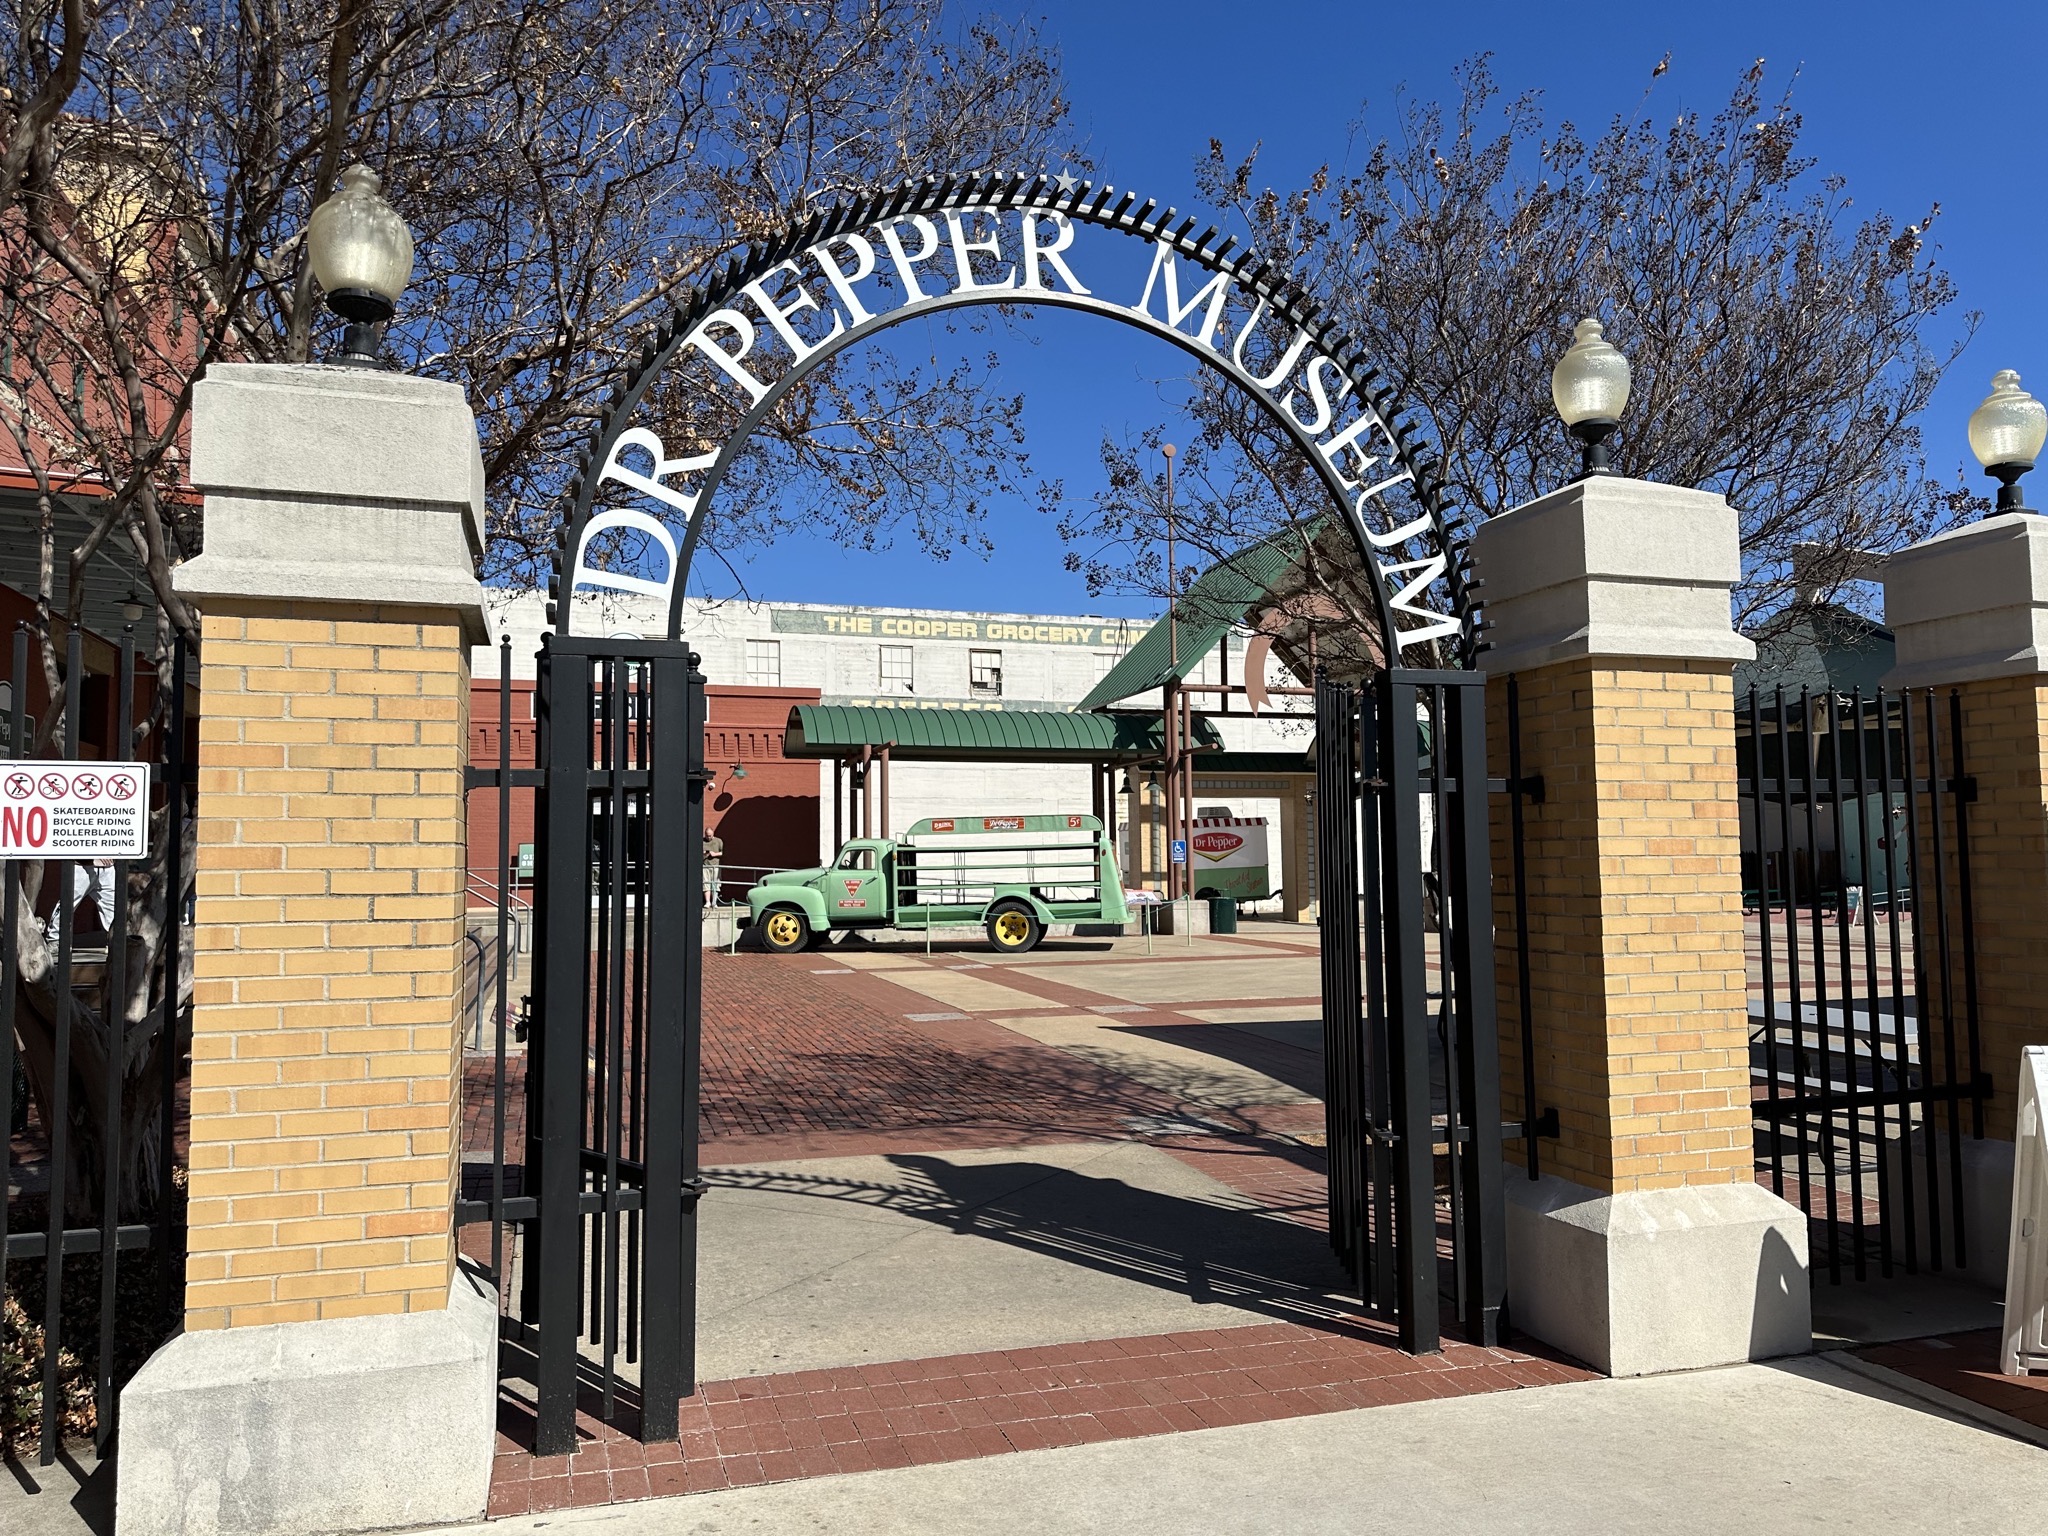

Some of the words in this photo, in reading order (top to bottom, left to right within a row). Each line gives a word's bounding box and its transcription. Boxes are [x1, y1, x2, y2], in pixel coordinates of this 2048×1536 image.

[574, 426, 722, 601] DR
[681, 206, 1092, 408] PEPPER
[1131, 239, 1463, 648] MUSEUM
[824, 615, 872, 633] THE
[881, 618, 978, 638] COOPER
[986, 623, 1094, 644] GROCERY
[1101, 629, 1147, 645] COM
[53, 807, 136, 815] SKATEBOARDING
[2, 806, 48, 848] NO
[53, 818, 94, 826] BICYCLE
[97, 818, 131, 826] RIDING
[52, 839, 98, 847] SCOOTER
[101, 839, 135, 847] RIDING
[1195, 839, 1206, 848] Dr
[1207, 836, 1238, 850] Pepper
